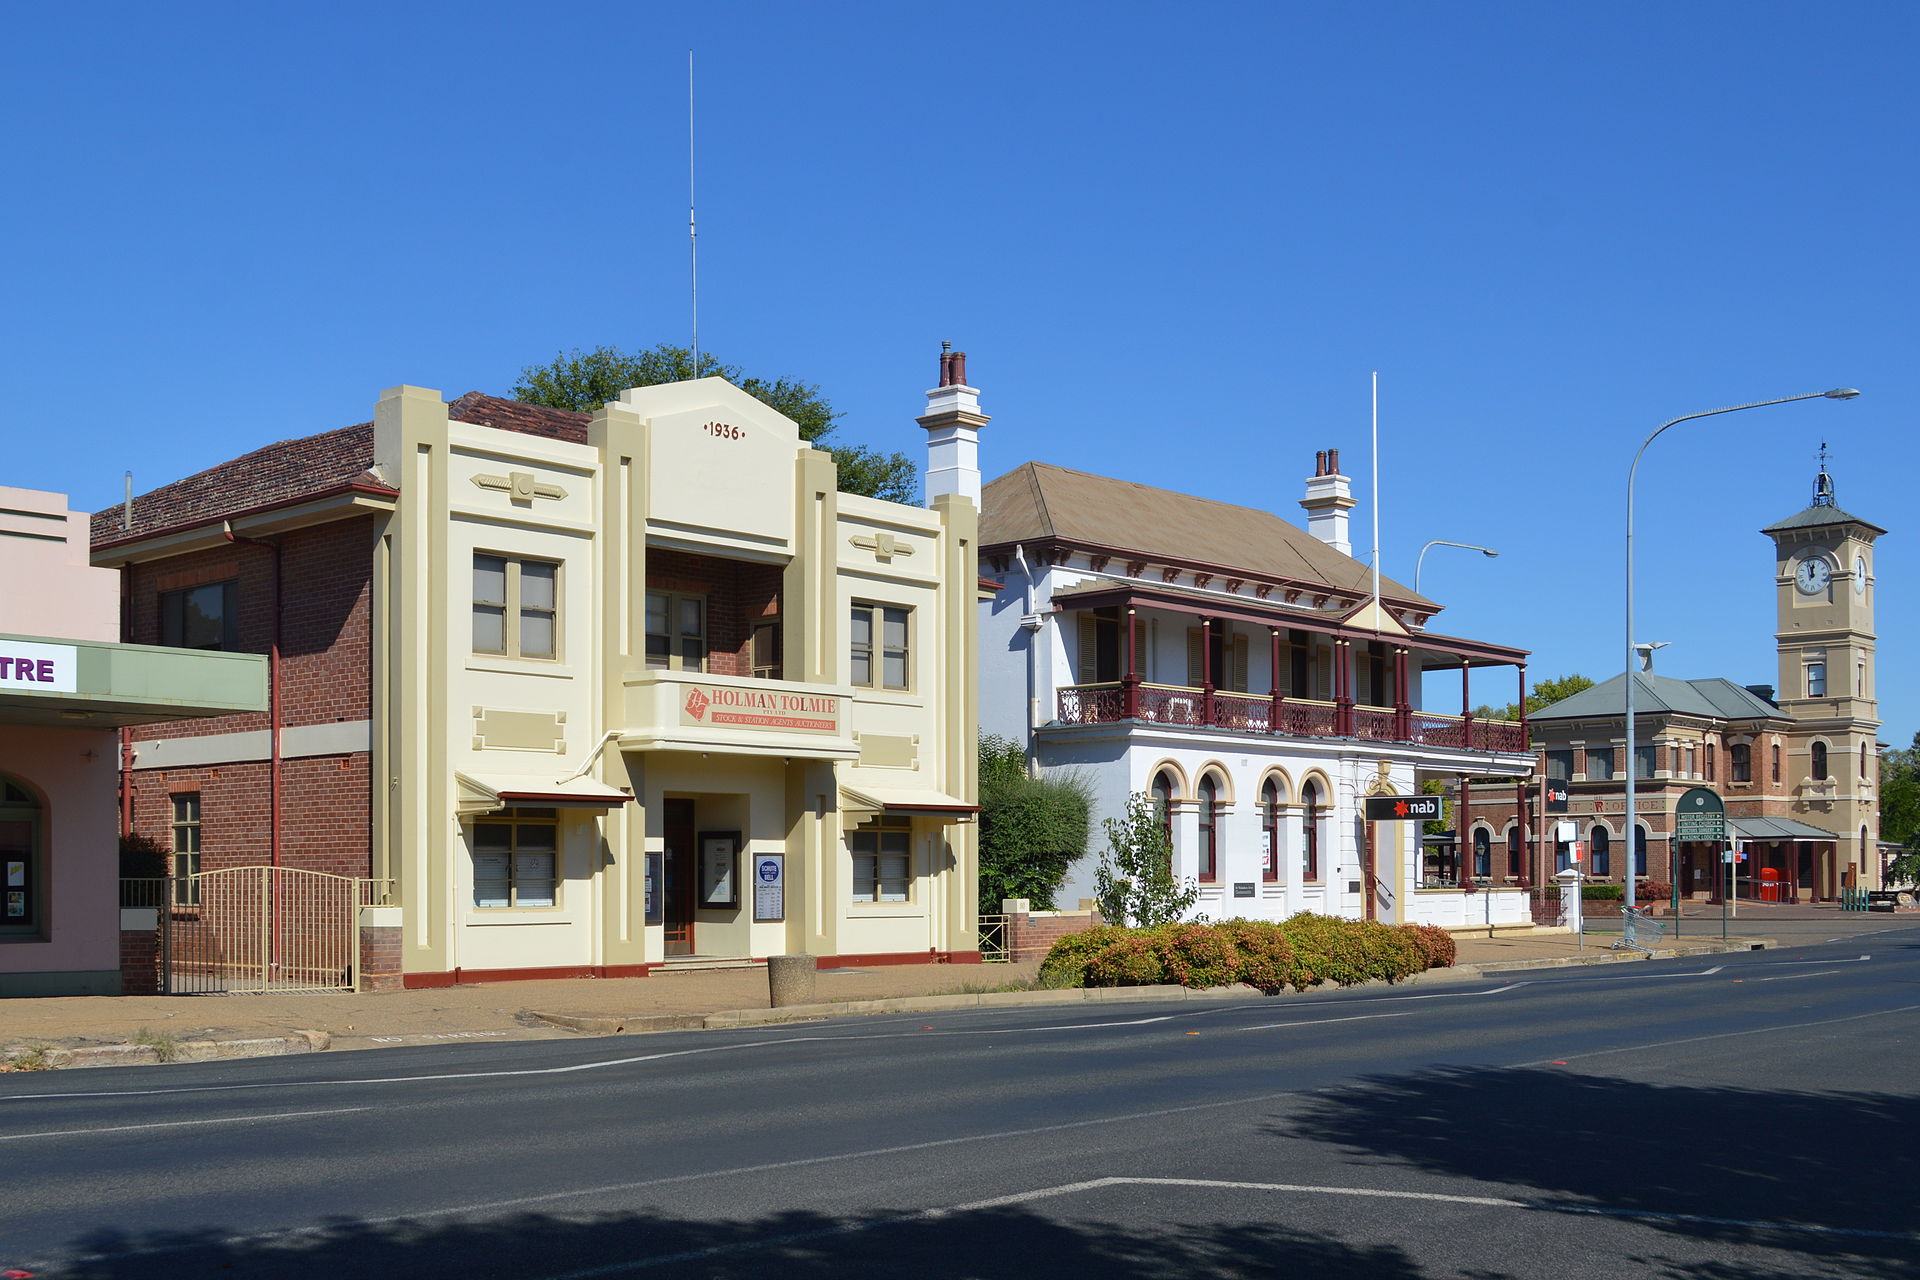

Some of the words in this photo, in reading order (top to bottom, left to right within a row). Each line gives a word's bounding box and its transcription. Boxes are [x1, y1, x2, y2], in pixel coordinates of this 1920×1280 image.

[712, 690, 777, 709] HOLMAN
[781, 696, 836, 713] TOLMIE
[716, 714, 736, 722] STOCK
[745, 716, 769, 725] STATION
[770, 718, 793, 727] AGENTS
[795, 719, 832, 729] AUCTIONEERS
[1555, 789, 1567, 801] nab
[1410, 800, 1435, 814] nab
[1612, 800, 1658, 810] OFICE
[421, 1031, 506, 1040] PARKING
